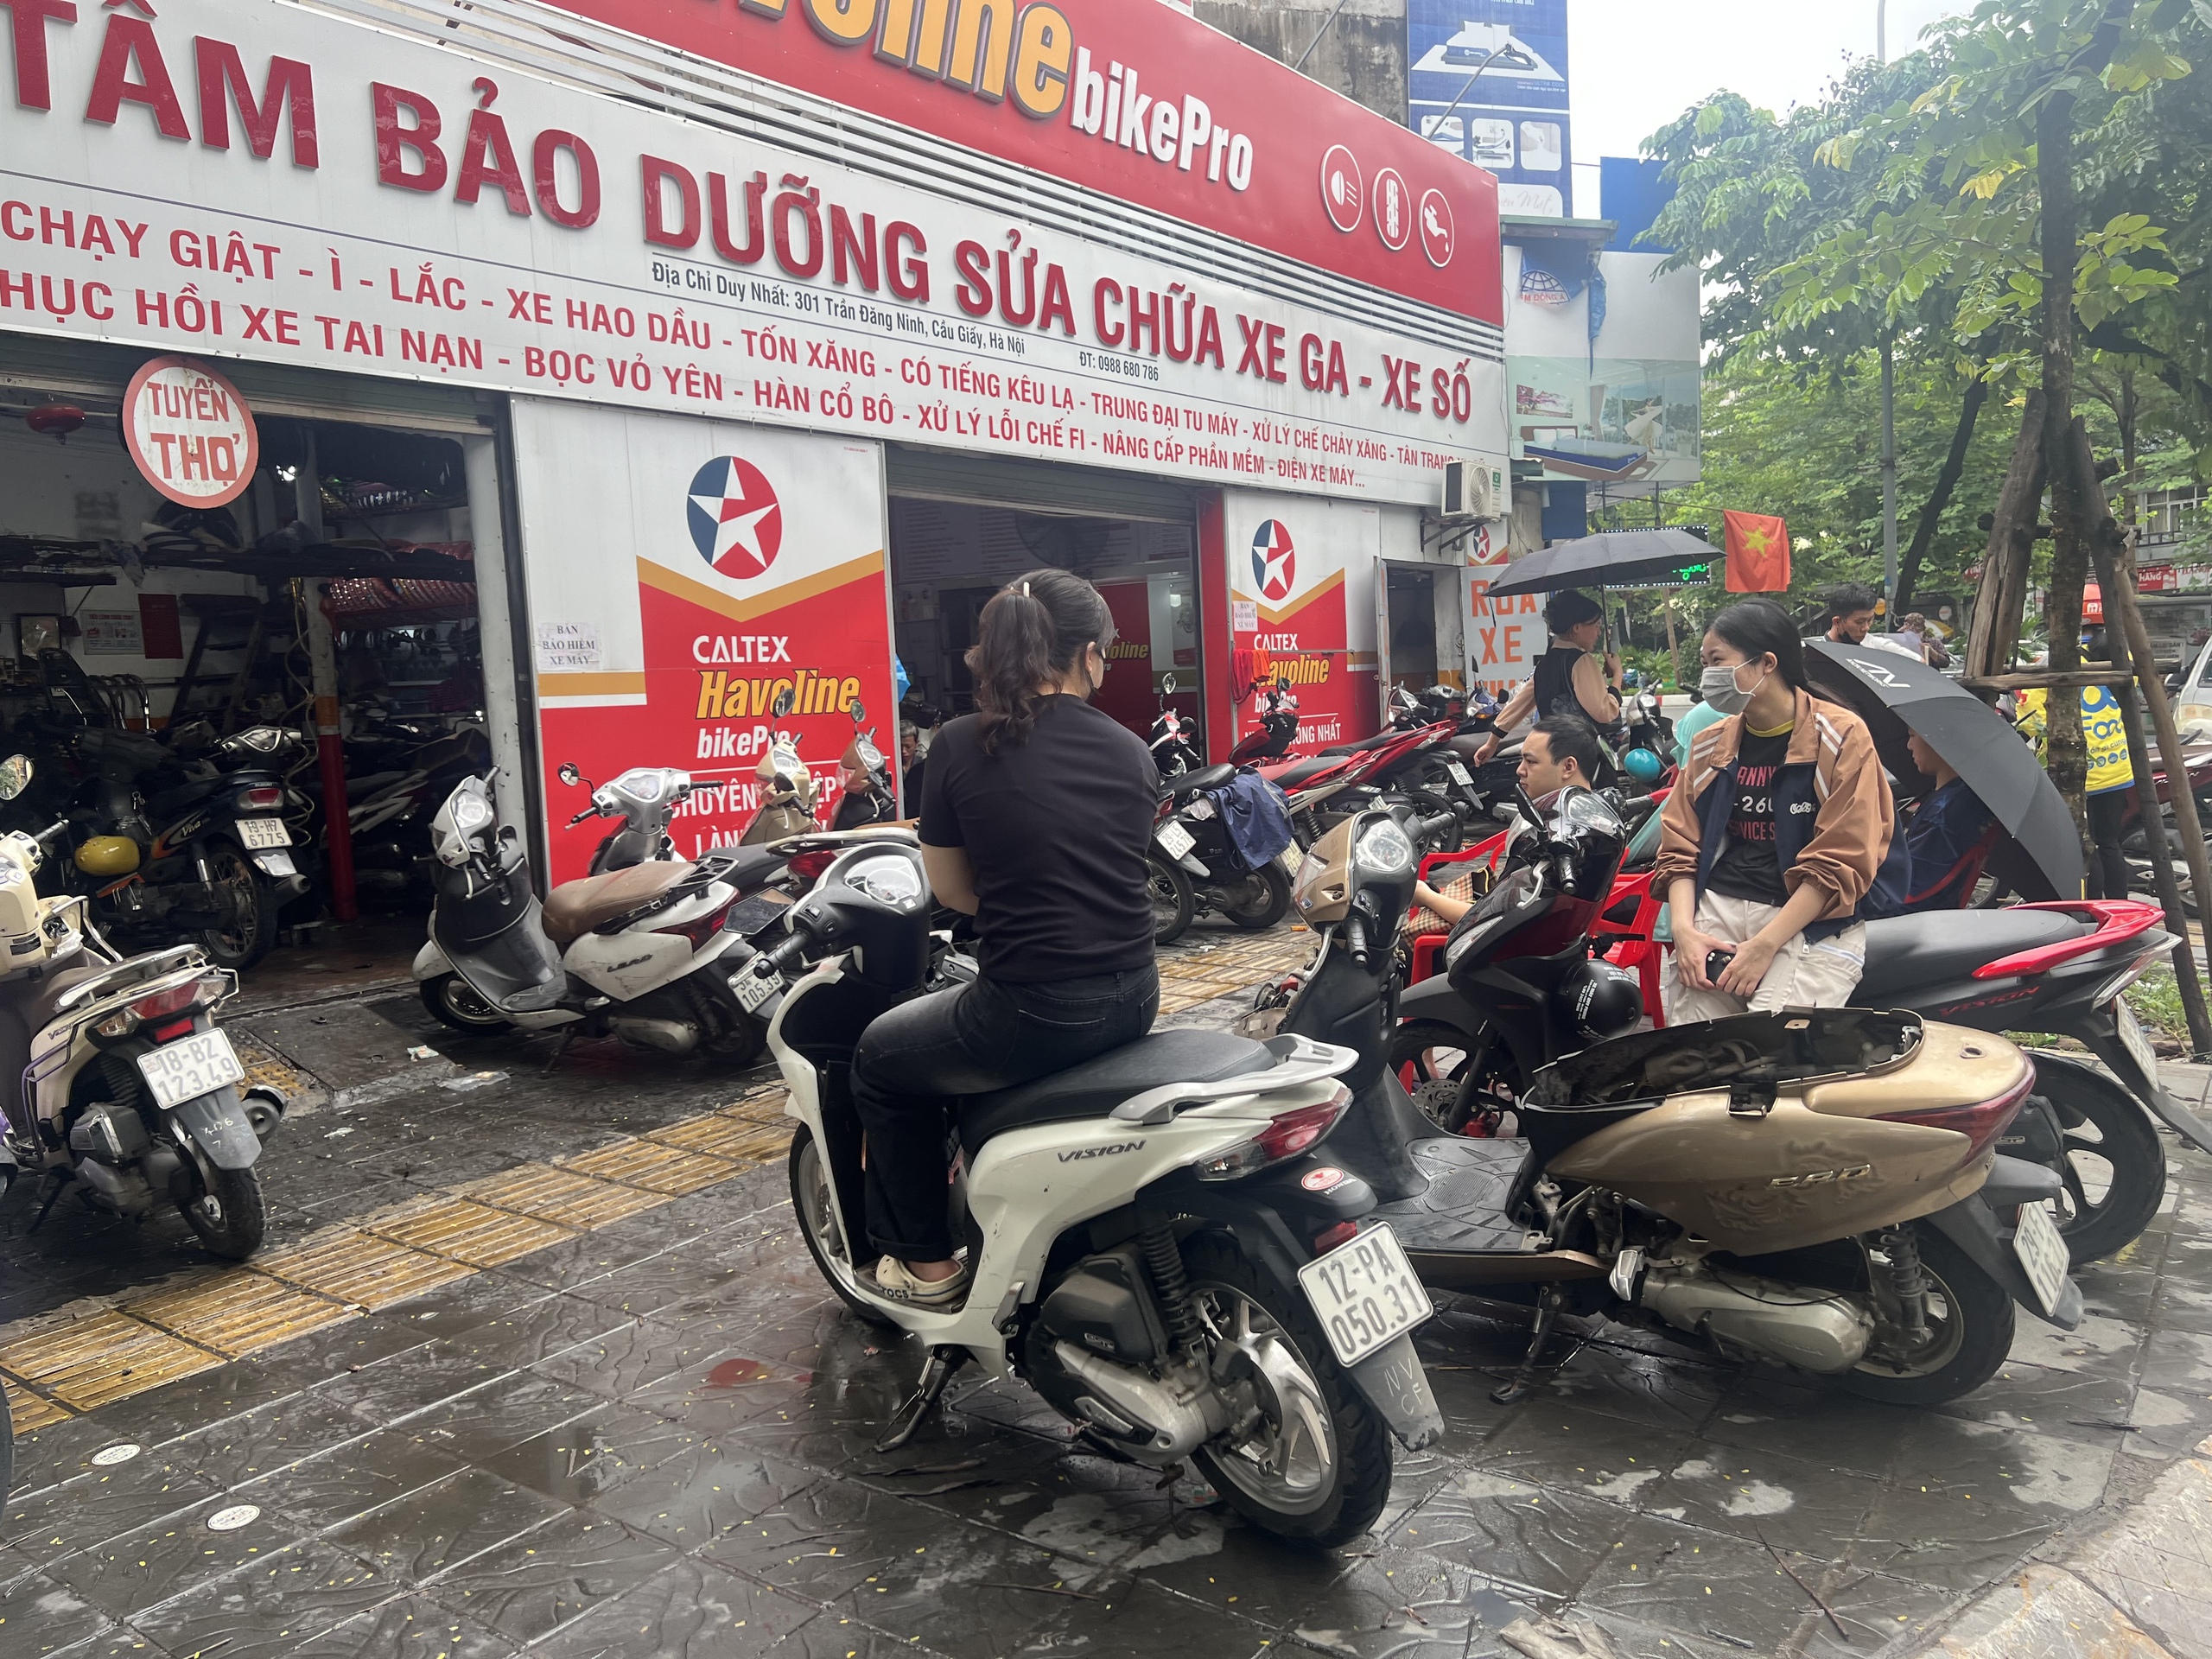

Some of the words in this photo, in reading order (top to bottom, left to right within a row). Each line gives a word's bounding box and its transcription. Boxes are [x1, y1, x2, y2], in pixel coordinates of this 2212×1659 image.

[1071, 46, 1255, 192] bikePro
[0, 0, 319, 168] TÂM
[371, 76, 601, 230] BẢO
[640, 154, 931, 302] DƯỠNG
[954, 229, 1077, 336] SỬA
[1093, 276, 1225, 370] CHỮA
[1236, 315, 1287, 384] XE
[1300, 333, 1351, 396] GA
[1382, 354, 1423, 412] XE
[1431, 358, 1471, 423] SỐ
[652, 261, 681, 288] Địa
[686, 267, 712, 292] Chỉ
[717, 275, 746, 302] Duy
[751, 281, 790, 308] Nhất:
[795, 290, 820, 313] 301
[825, 297, 855, 321] Trần
[859, 304, 893, 332] Đăng
[897, 312, 928, 338] Ninh,
[932, 319, 955, 340] Cầu
[958, 325, 987, 349] Giấy,
[989, 331, 1004, 351] Hà
[1007, 335, 1026, 357] Nội
[1, 200, 149, 261] CHẠY
[169, 230, 281, 283] GIẬT
[328, 247, 343, 291] Ì
[391, 262, 467, 311] LẮC
[508, 289, 553, 325] XE
[566, 298, 636, 339] HAO
[648, 307, 711, 350] DẦU
[741, 324, 798, 364] TỐN
[807, 346, 875, 378] XĂNG
[900, 351, 931, 386] CÓ
[938, 361, 1001, 398] TIẾNG
[1007, 372, 1045, 405] KÊU
[1052, 385, 1074, 415] LẠ
[1091, 391, 1148, 423] TRUNG
[1152, 404, 1179, 432] ĐẠI
[1184, 409, 1203, 431] TU
[1207, 411, 1239, 437] MÁY
[1253, 417, 1272, 443] XỬ
[1275, 423, 1290, 445] LÝ
[1294, 427, 1319, 451] CHẾ
[1322, 432, 1352, 456] CHẢY
[1357, 438, 1387, 461] XĂNG
[1397, 445, 1418, 467] TÂN
[0, 270, 115, 324] HỤC
[136, 283, 223, 335] HỒI
[241, 304, 301, 346] XE
[315, 315, 384, 357] TAI
[400, 327, 483, 374] NẠN
[524, 346, 596, 387] BỌC
[607, 353, 652, 391] VỎ
[662, 363, 723, 401] YÊN
[754, 376, 810, 412] HÀN
[820, 381, 854, 419] CỔ
[862, 393, 894, 424] BÔ
[918, 399, 949, 432] XỬ
[956, 404, 982, 435] LÝ
[988, 408, 1021, 442] LỖI
[1027, 417, 1065, 448] CHẾ
[1069, 427, 1086, 450] FI
[1103, 430, 1149, 459] NÂNG
[1154, 435, 1184, 463] CẤP
[1189, 441, 1229, 470] PHẦN
[1233, 447, 1265, 474] MỀM
[1277, 456, 1307, 483] ĐIỆN
[1310, 464, 1326, 483] XE
[1079, 351, 1096, 369] ĐT:
[1098, 355, 1121, 374] 0988
[1123, 360, 1140, 378] 680
[1142, 364, 1159, 381] 786
[146, 378, 230, 423] TUYỂN
[149, 433, 242, 487] THỢ
[550, 656, 564, 665] XE
[567, 652, 590, 664] MÁY
[692, 635, 792, 664] CALTEX
[1254, 633, 1299, 651] CALTEX
[1478, 625, 1522, 665] XE
[1256, 653, 1331, 688] avoline
[1318, 716, 1341, 741] NHẤT
[181, 820, 202, 837] Viva
[249, 832, 285, 847] 6775
[1160, 823, 1183, 846] 29-L5
[1168, 832, 1193, 858] 245.78
[741, 974, 781, 1008] 105.39
[156, 1037, 219, 1076] 18-B2
[157, 1057, 238, 1102] 123.49
[1057, 1139, 1147, 1163] VISION
[1323, 1178, 1357, 1196] HONDA
[1318, 1236, 1396, 1305] 12-PA
[1331, 1274, 1423, 1355] 050.31
